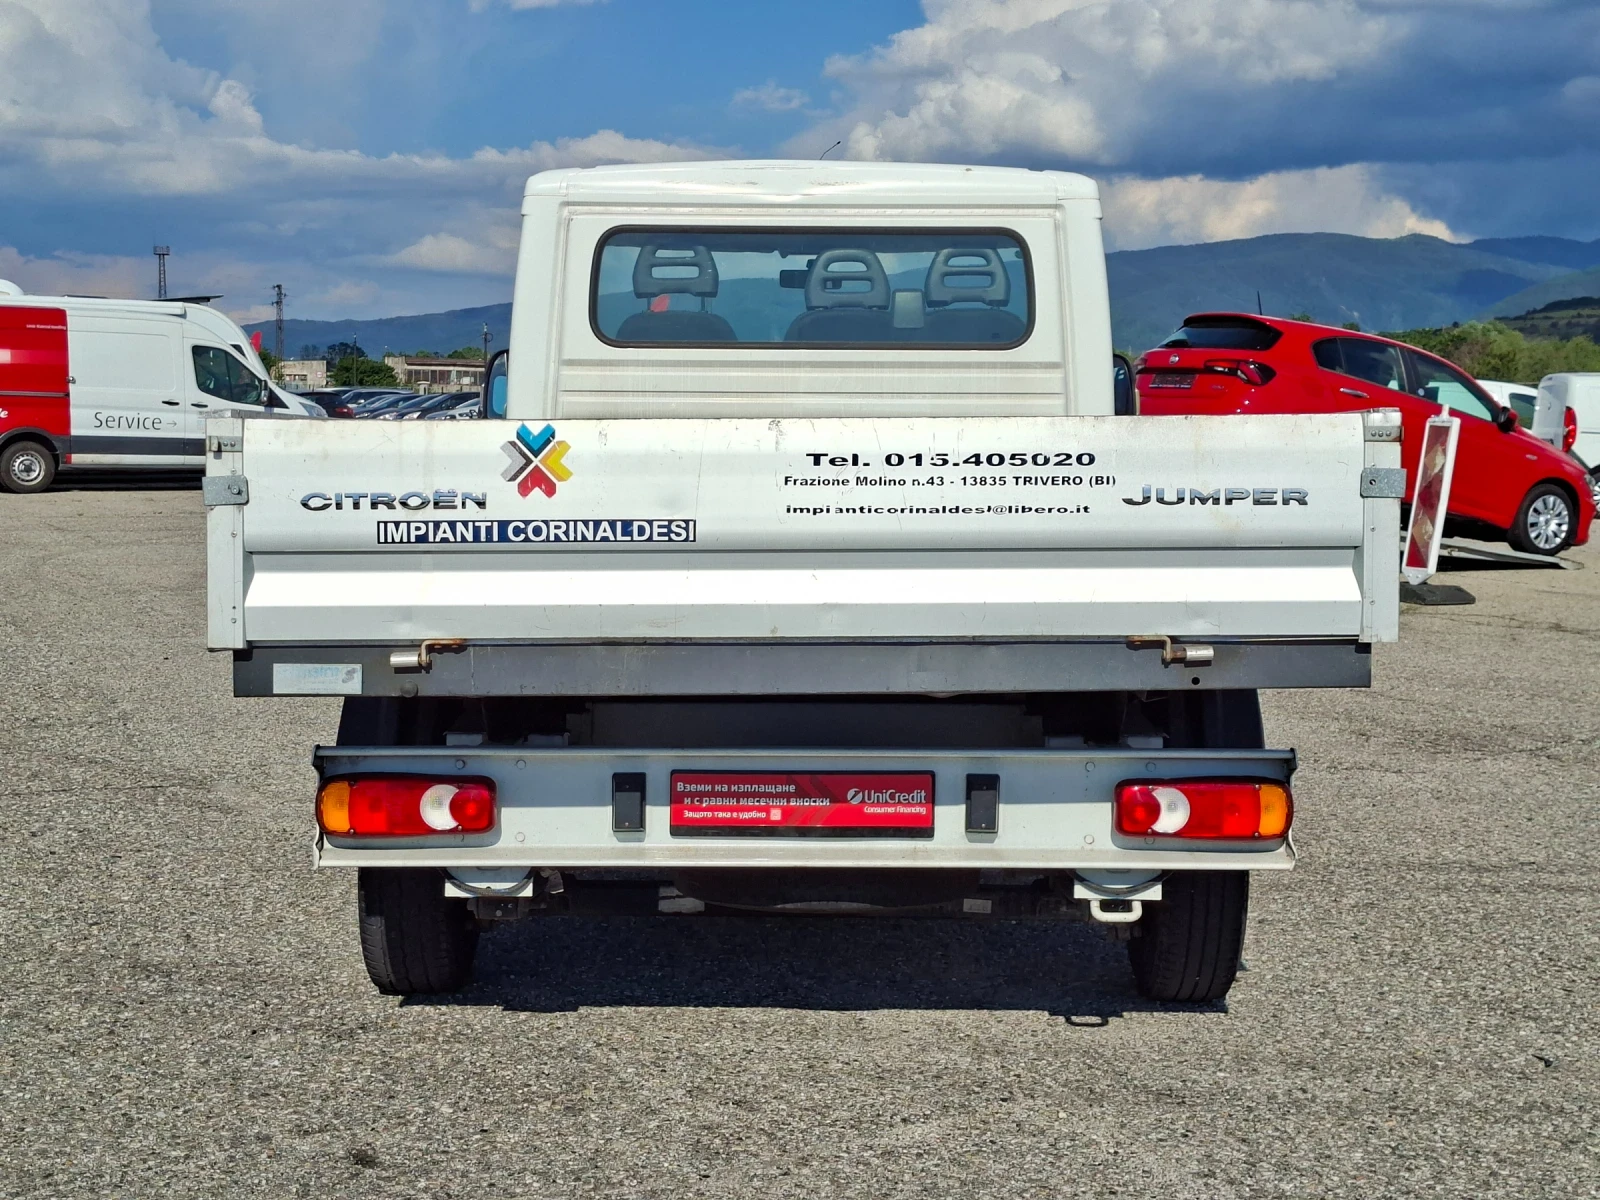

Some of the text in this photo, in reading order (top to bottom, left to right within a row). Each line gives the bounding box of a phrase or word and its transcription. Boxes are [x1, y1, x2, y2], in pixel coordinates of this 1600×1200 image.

[94, 411, 162, 430] Service
[805, 453, 1096, 467] Tel. 015.405020
[784, 476, 850, 486] Frazione
[855, 476, 906, 486] Molino
[911, 476, 945, 486] n.43
[960, 476, 1007, 486] 13835
[1012, 476, 1083, 486] TRIVERO
[1089, 475, 1116, 488] (BI)
[300, 489, 487, 511] CITROËN
[1121, 484, 1309, 506] JUMPER
[379, 520, 694, 542] IMPIANTI CORINALDESI
[677, 782, 796, 794] Вземи на изплащане
[684, 797, 830, 807] и с равни месечни вноски
[864, 789, 926, 804] UniCredit
[683, 810, 712, 819] Защото
[738, 811, 766, 820] удобно
[896, 806, 926, 815] Financing
